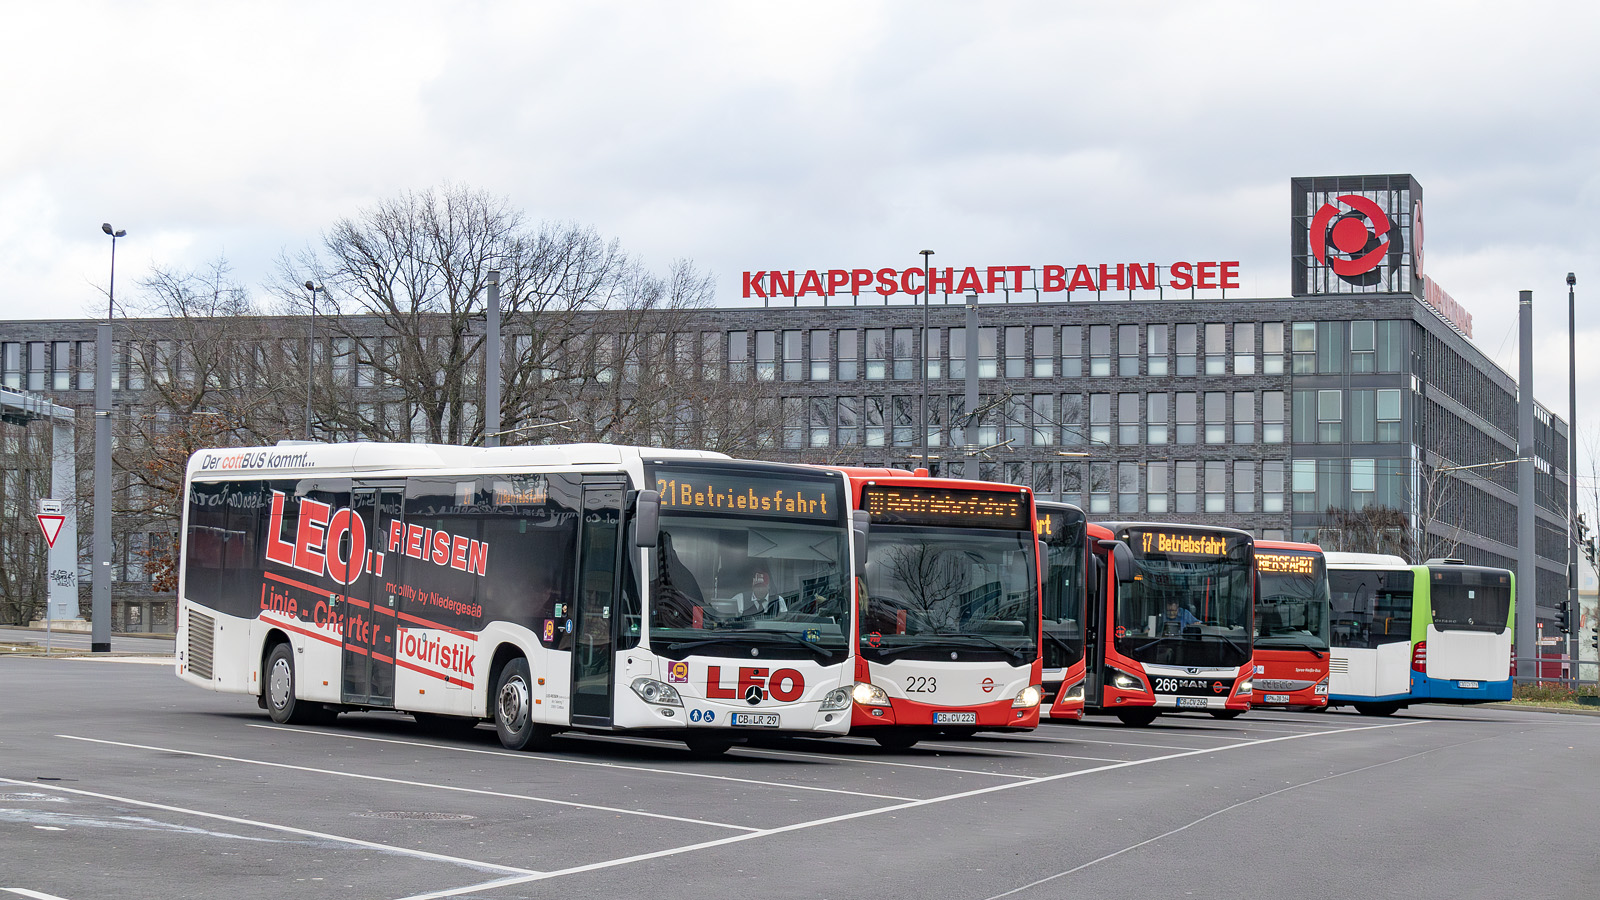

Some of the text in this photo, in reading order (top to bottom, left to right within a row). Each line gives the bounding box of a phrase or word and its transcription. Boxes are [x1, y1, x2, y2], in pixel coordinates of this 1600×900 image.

[742, 261, 1240, 298] KNAPPSCHAFT BAHN SEE
[202, 451, 315, 469] Der cottBUS kommt...
[657, 479, 827, 514] 21 Betriebsfahrt
[388, 518, 489, 577] REISEN
[1158, 533, 1227, 555] Betriebsfahrt
[418, 588, 429, 606] by
[429, 591, 482, 618] Niedergesäß
[260, 582, 298, 619] Linie
[314, 600, 380, 646] Charter
[397, 624, 476, 677] Touristik
[706, 665, 805, 703] LEO
[905, 676, 937, 693] 223
[1155, 678, 1178, 692] 266
[1179, 680, 1208, 689] MAN
[738, 714, 776, 724] CB LR 29
[938, 714, 974, 723] CB CV 223
